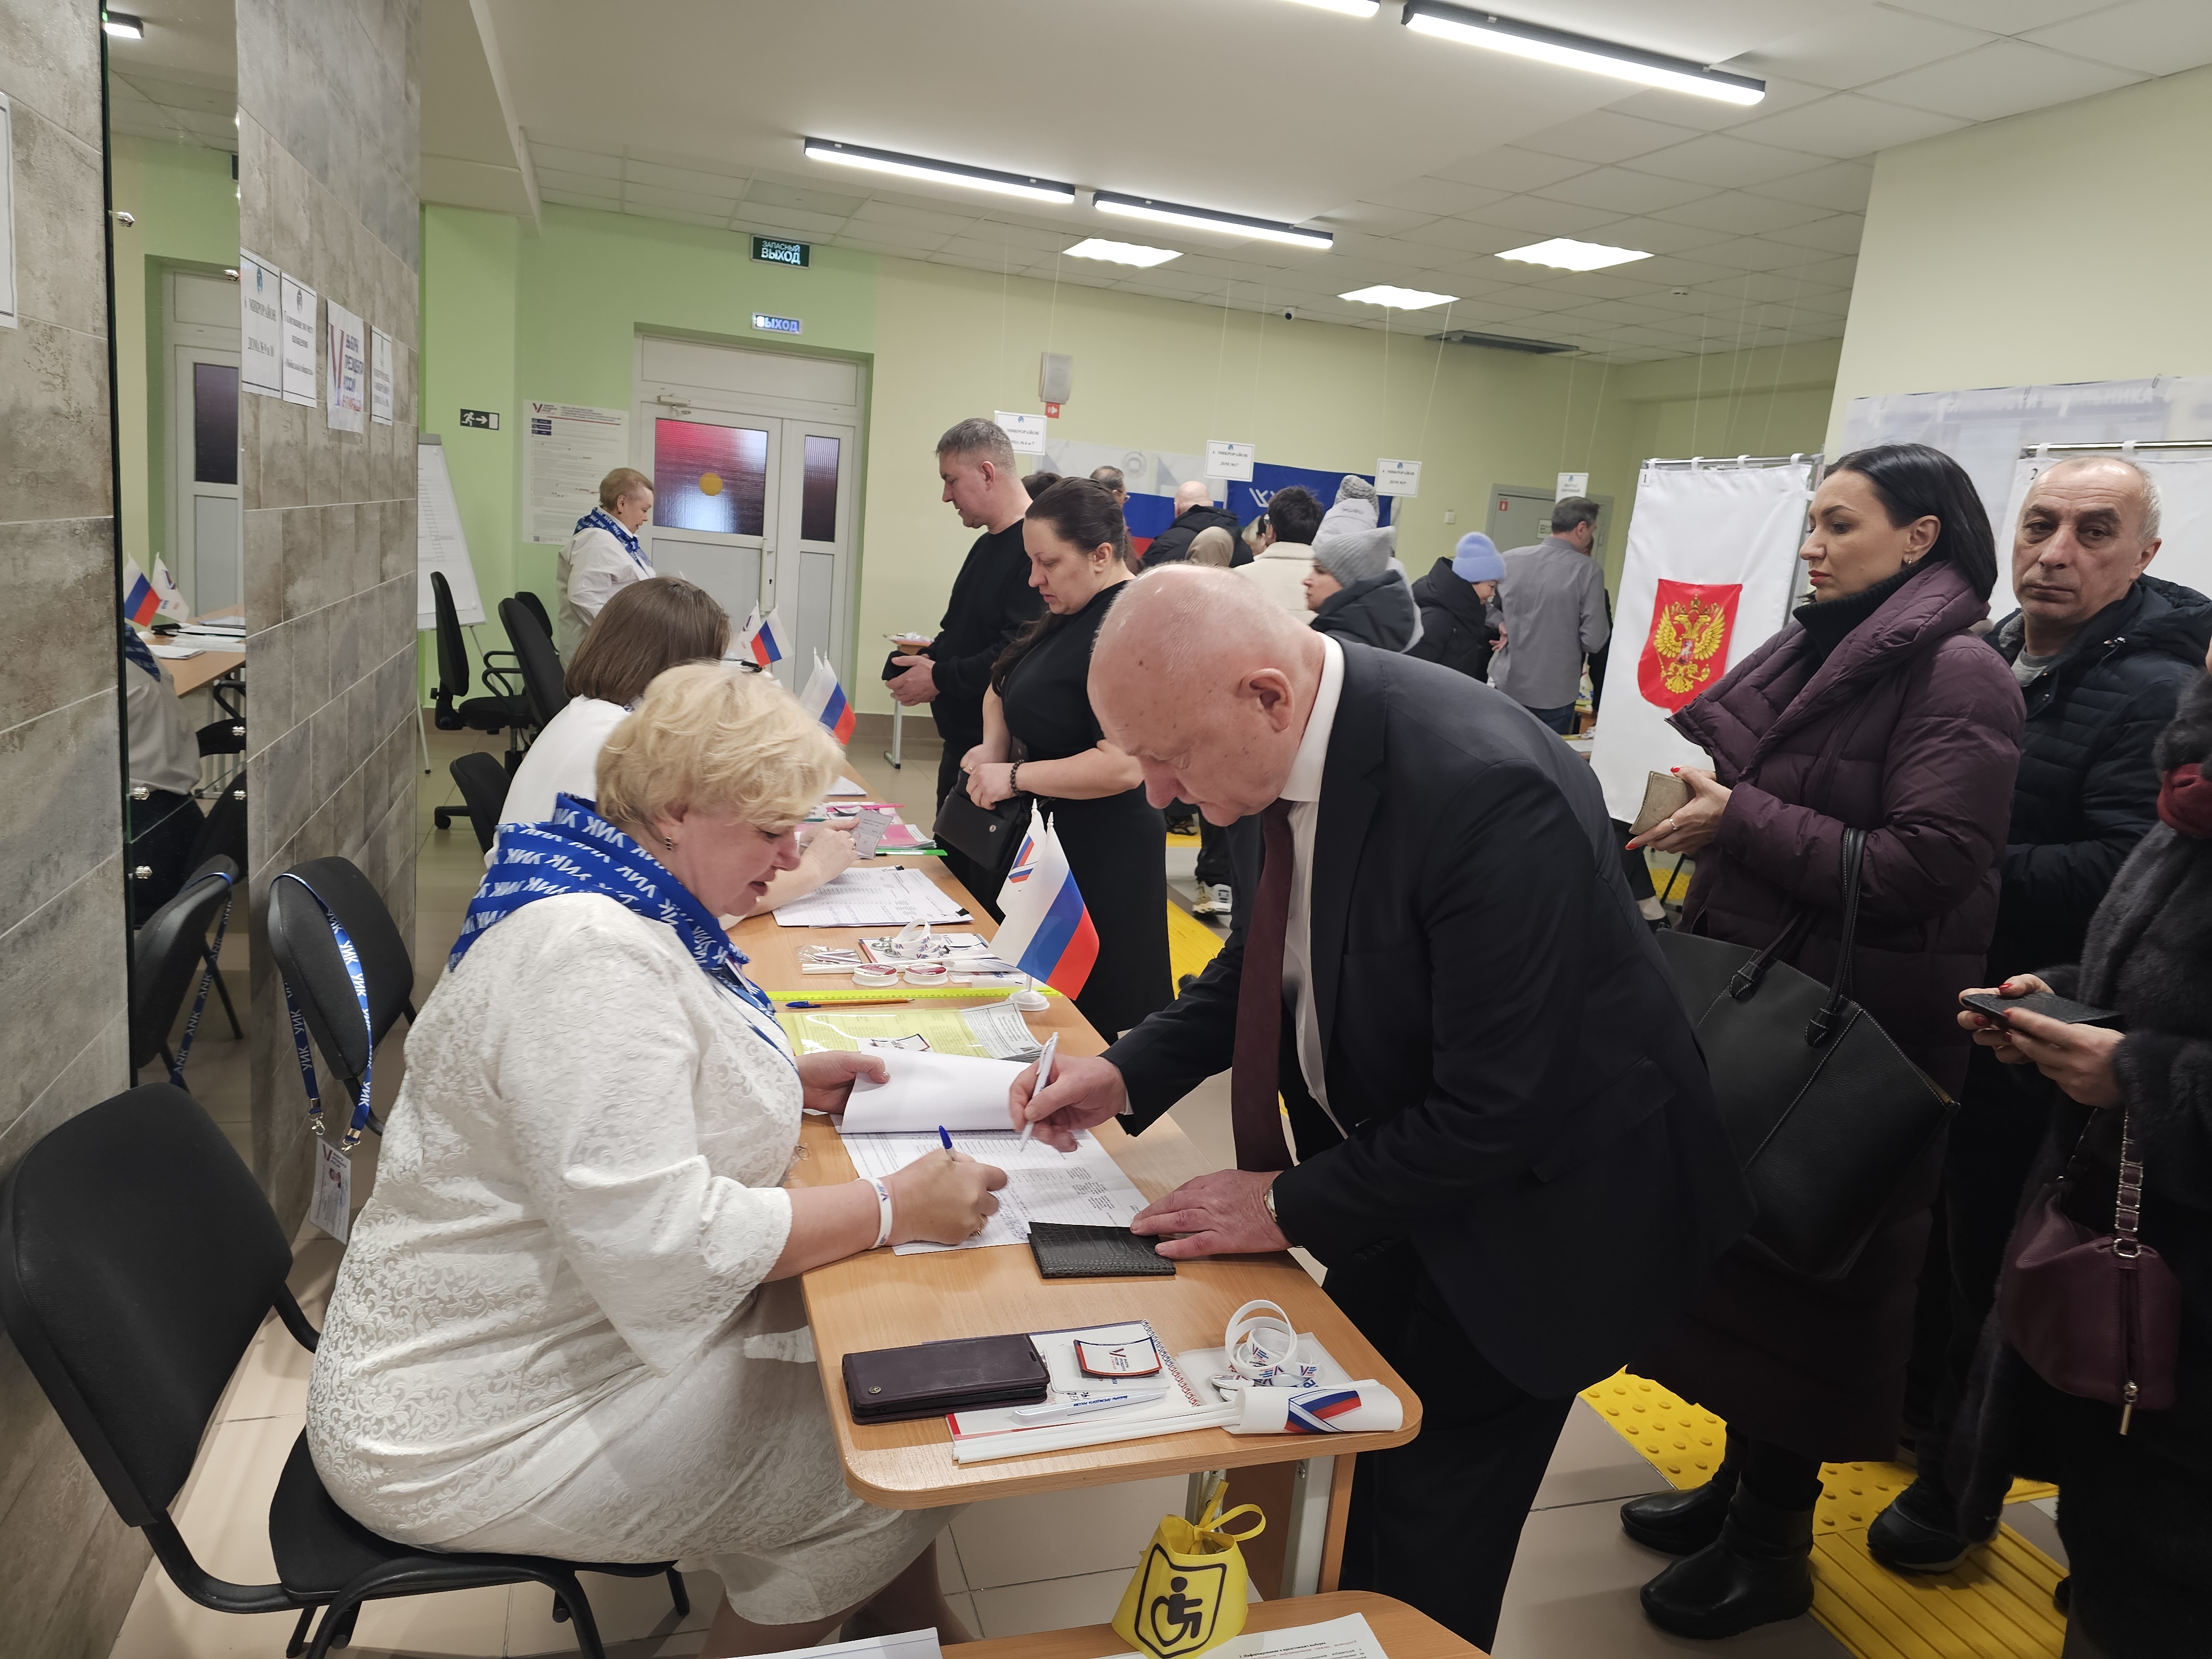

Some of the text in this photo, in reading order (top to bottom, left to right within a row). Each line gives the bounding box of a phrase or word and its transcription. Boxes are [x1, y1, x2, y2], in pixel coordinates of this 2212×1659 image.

[761, 247, 801, 265] ВЫХОД
[762, 241, 800, 252] ЗАПАСНЫЙ
[581, 816, 628, 848] УИК
[503, 848, 547, 864] УИК
[544, 854, 593, 881] УИК
[614, 865, 659, 899] УИК
[339, 940, 359, 966] УИК
[351, 973, 367, 997] УИК
[290, 1009, 305, 1035] УИК
[298, 1045, 312, 1071] УИК
[358, 1081, 371, 1107] УИК
